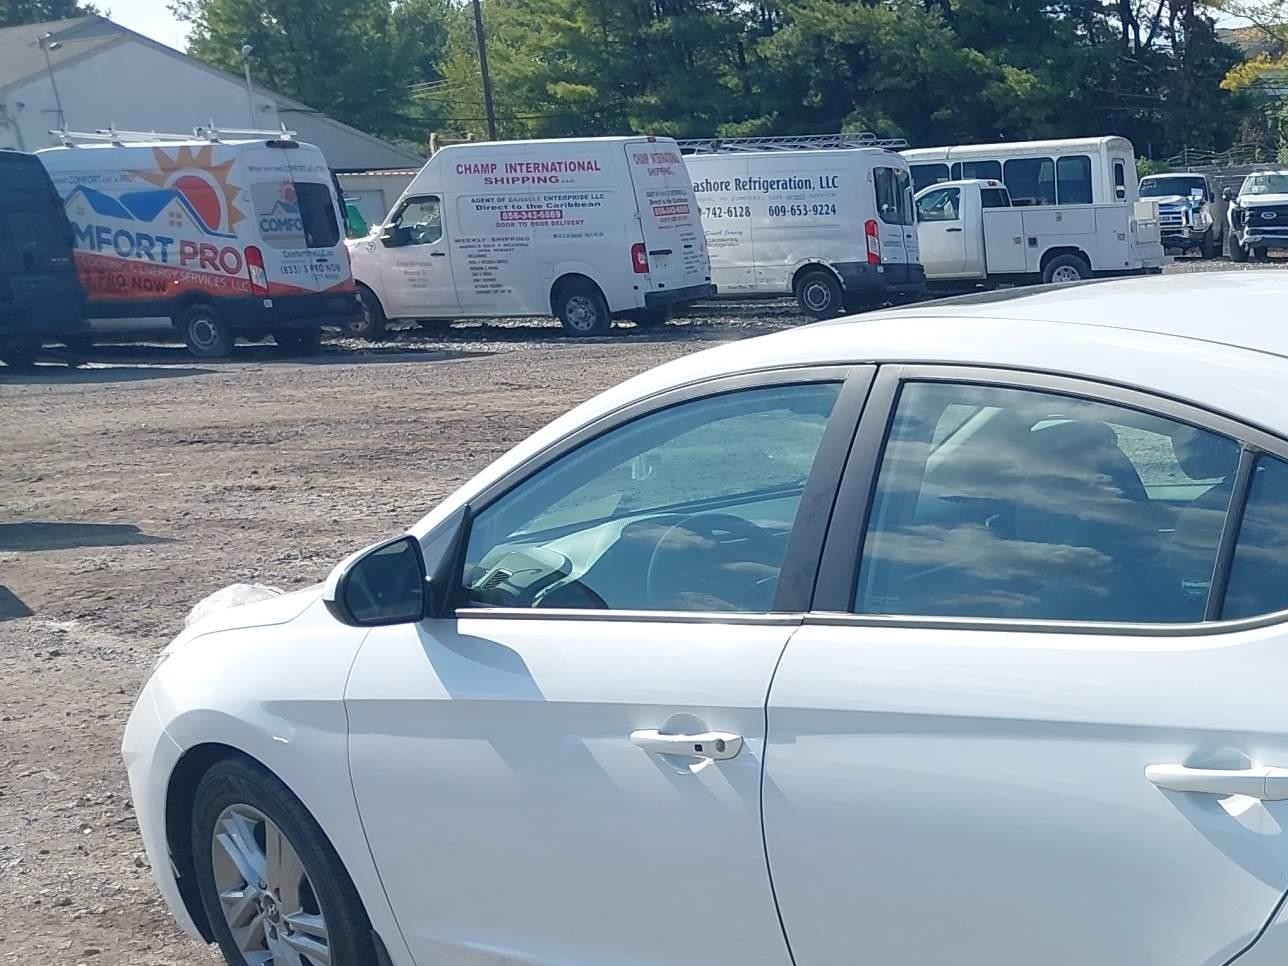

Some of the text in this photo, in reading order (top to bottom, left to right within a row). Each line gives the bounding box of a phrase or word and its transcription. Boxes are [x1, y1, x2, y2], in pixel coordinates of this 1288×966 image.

[456, 160, 601, 175] CHAMP INTERNATIONAL
[484, 176, 560, 185] SHIPPING
[693, 175, 839, 194] ashore Refrigeration, LLC
[543, 194, 589, 202] ENTERPRISE
[768, 203, 837, 217] 609-653-9224
[180, 239, 243, 275] PRO
[98, 270, 126, 287] PRO
[131, 277, 168, 292] NOW
[231, 280, 249, 292] LLC
